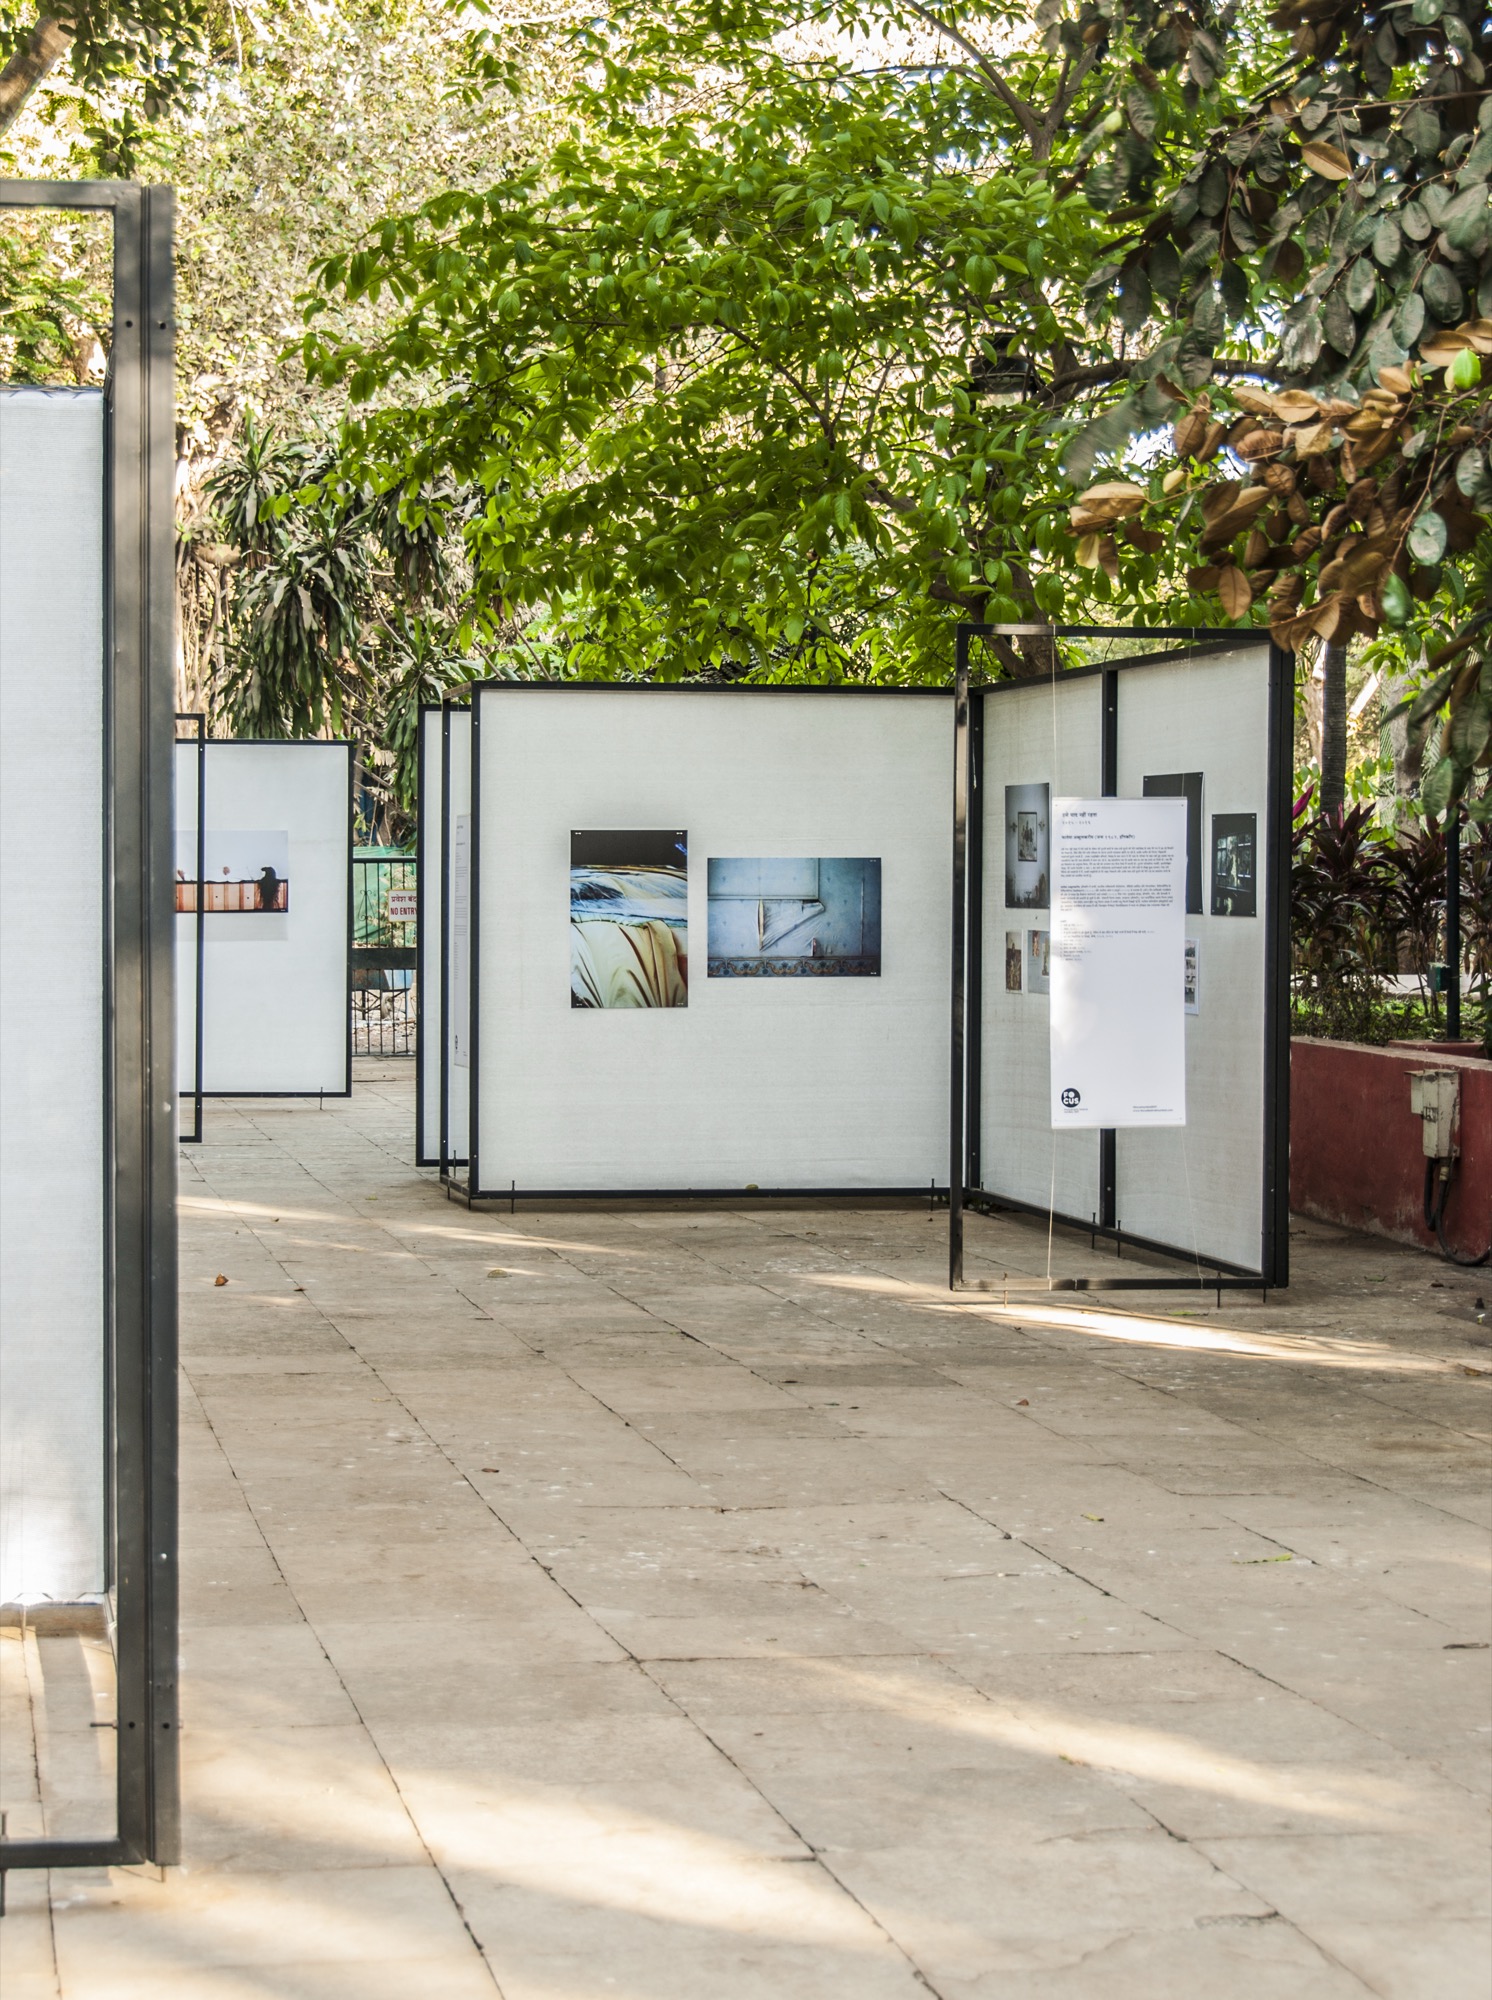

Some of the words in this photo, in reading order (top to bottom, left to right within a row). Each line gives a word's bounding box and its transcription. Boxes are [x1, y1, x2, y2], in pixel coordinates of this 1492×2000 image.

[391, 894, 406, 902] प्रवेश
[390, 907, 399, 915] NO
[1063, 1097, 1079, 1105] CUS
